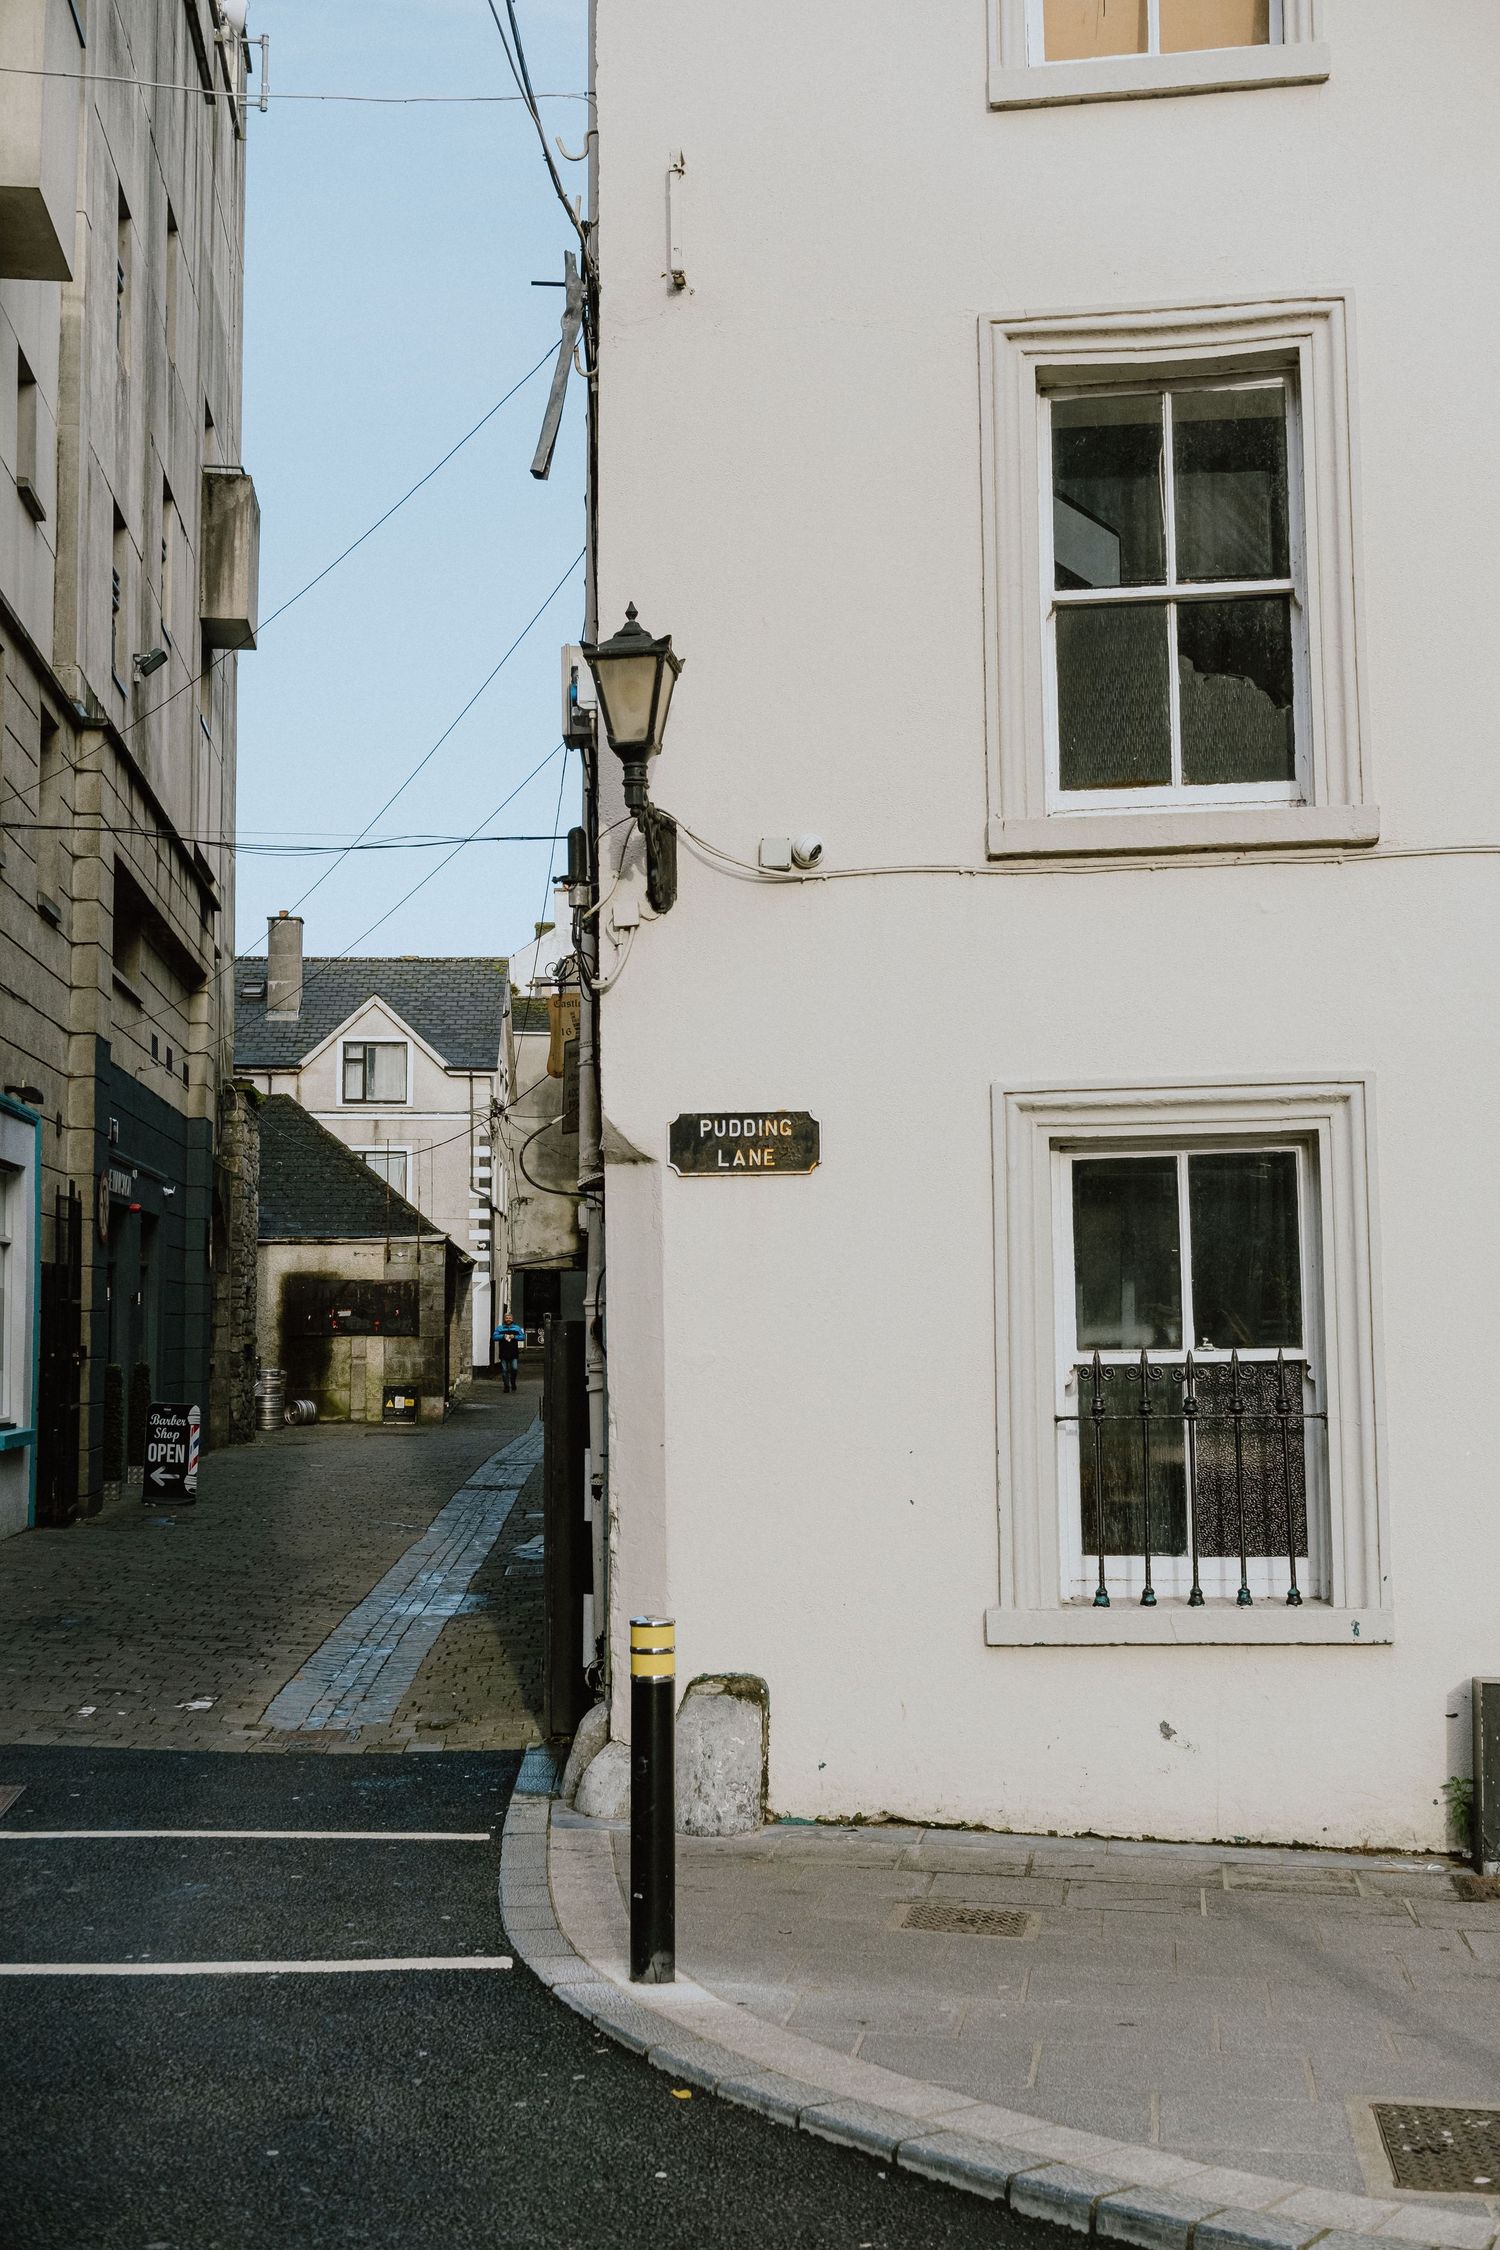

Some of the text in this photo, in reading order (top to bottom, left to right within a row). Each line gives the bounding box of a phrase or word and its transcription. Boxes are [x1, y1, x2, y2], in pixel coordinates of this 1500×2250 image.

[700, 1119, 792, 1138] PUDDING
[718, 1149, 776, 1167] LANE
[149, 1413, 186, 1427] Barber
[153, 1427, 180, 1443] Shop
[147, 1443, 185, 1463] OPEN
